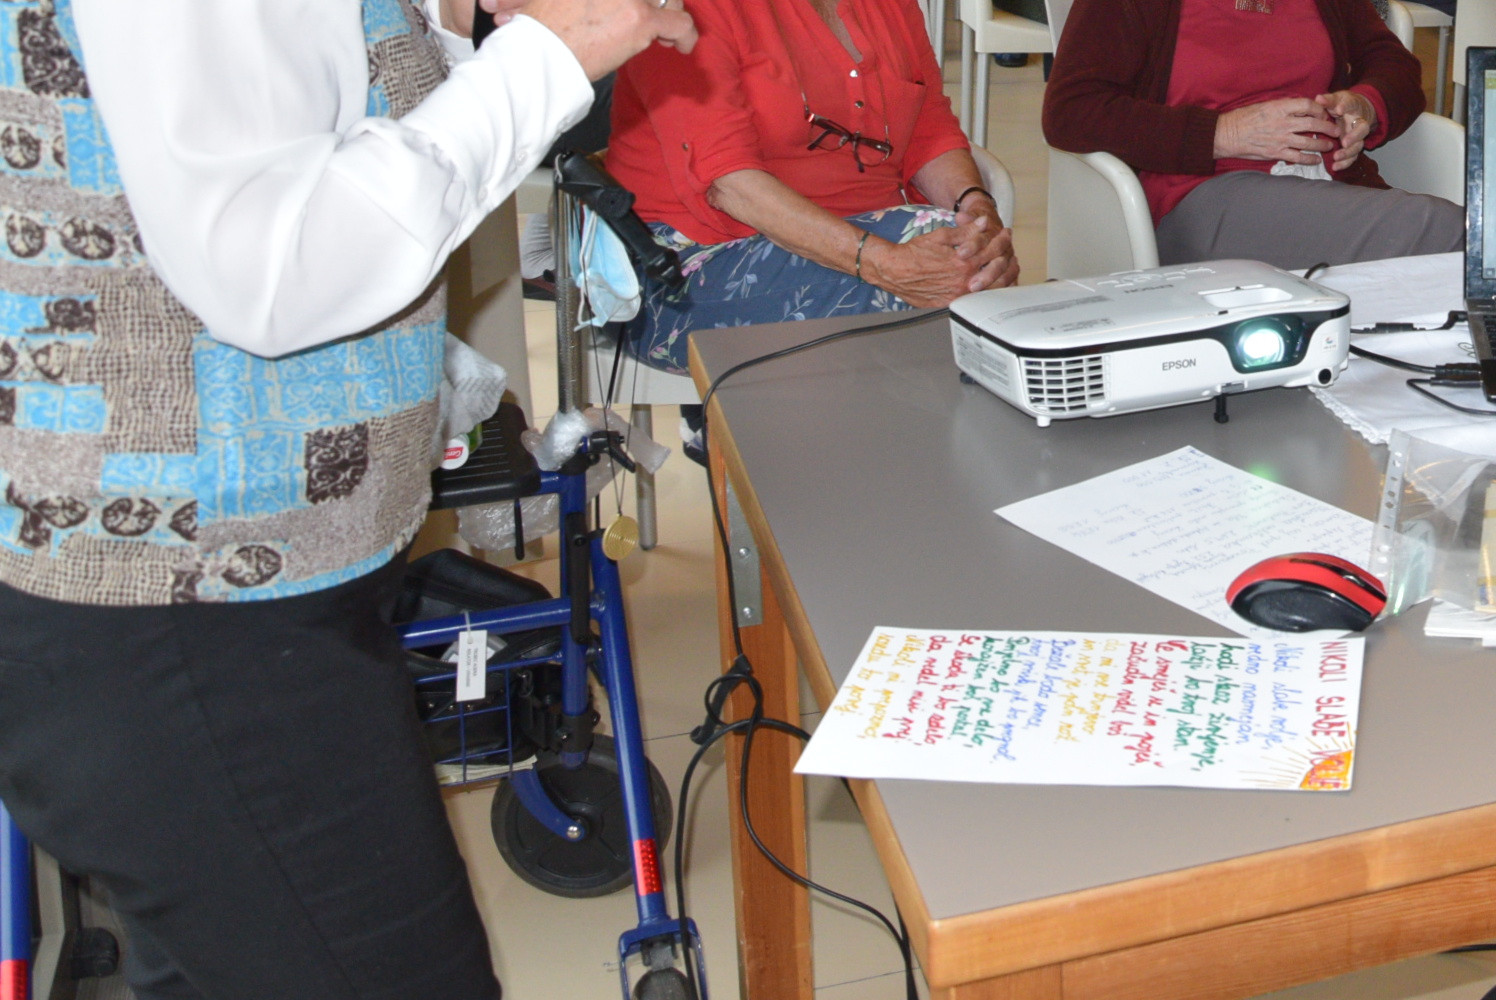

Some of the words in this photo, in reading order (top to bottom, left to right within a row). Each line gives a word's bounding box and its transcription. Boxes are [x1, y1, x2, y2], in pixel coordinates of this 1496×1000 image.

[1162, 359, 1197, 371] EPSON
[927, 636, 951, 652] da
[1217, 643, 1244, 670] hodi
[1273, 644, 1304, 672] Nikoli
[1318, 642, 1348, 682] NIKOLI
[1184, 676, 1213, 690] bo
[1112, 689, 1136, 714] videl
[1166, 693, 1207, 716] tvoj
[1272, 682, 1302, 711] slabe
[1144, 712, 1166, 726] in
[1312, 696, 1348, 737] SLABE
